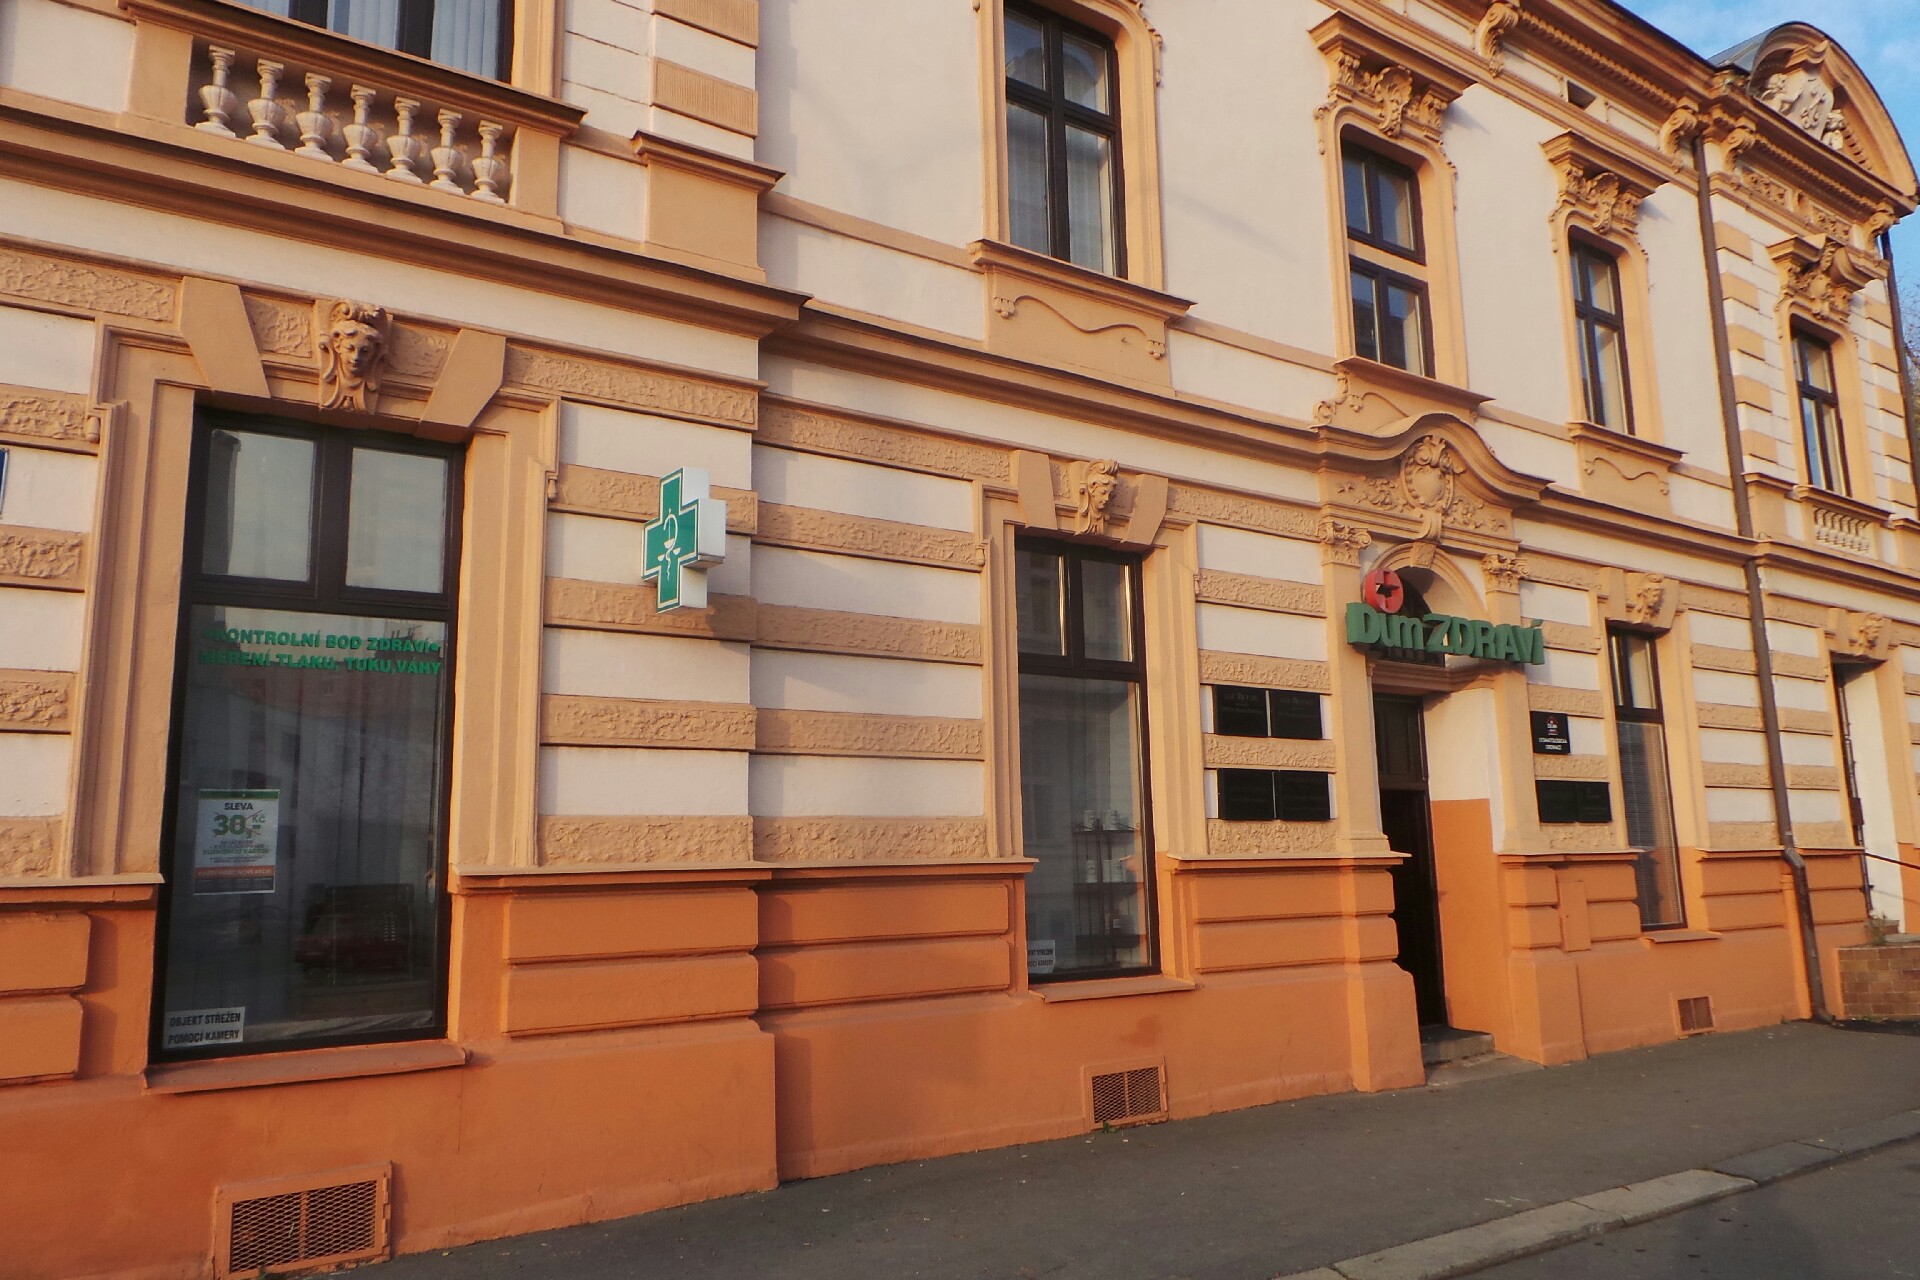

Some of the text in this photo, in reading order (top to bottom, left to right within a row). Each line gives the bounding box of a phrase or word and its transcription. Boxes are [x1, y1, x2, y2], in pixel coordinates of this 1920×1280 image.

[326, 634, 363, 650] BOD
[367, 637, 431, 653] ZDRAVÍ
[224, 802, 253, 811] SLEVA
[169, 1010, 241, 1027] OBJEKT STŘEŽEN
[167, 1029, 240, 1045] POMOCÍ KAMERY
